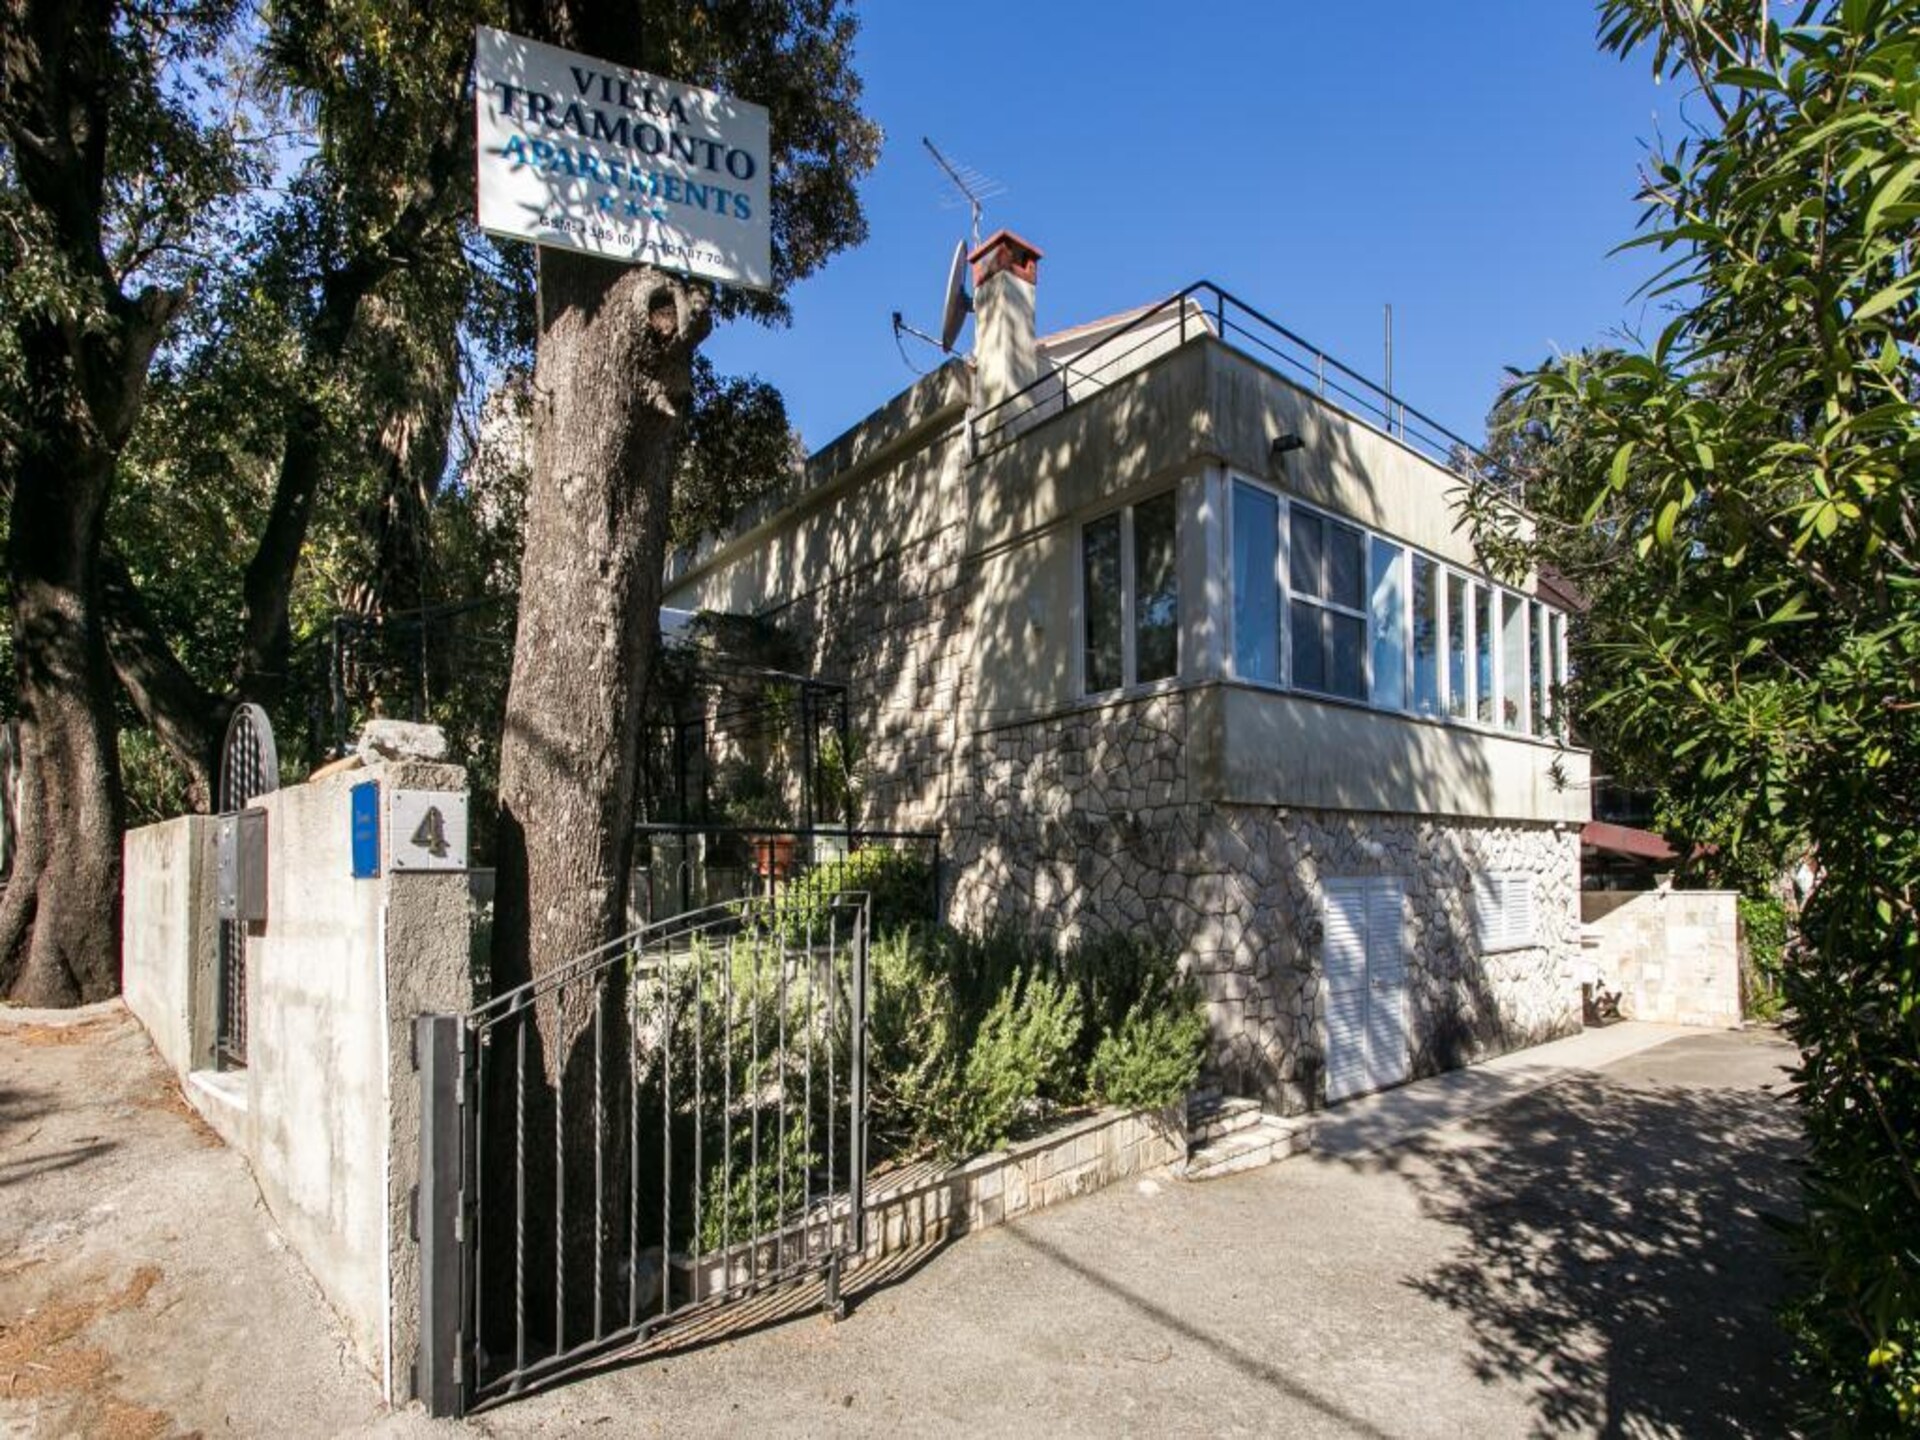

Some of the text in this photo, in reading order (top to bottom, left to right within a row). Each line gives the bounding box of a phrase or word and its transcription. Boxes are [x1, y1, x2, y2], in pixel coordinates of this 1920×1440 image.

[494, 81, 756, 181] TRAMONTO
[570, 66, 690, 125] VILLA
[502, 134, 752, 221] APARTMENTS
[410, 805, 446, 857] 4
